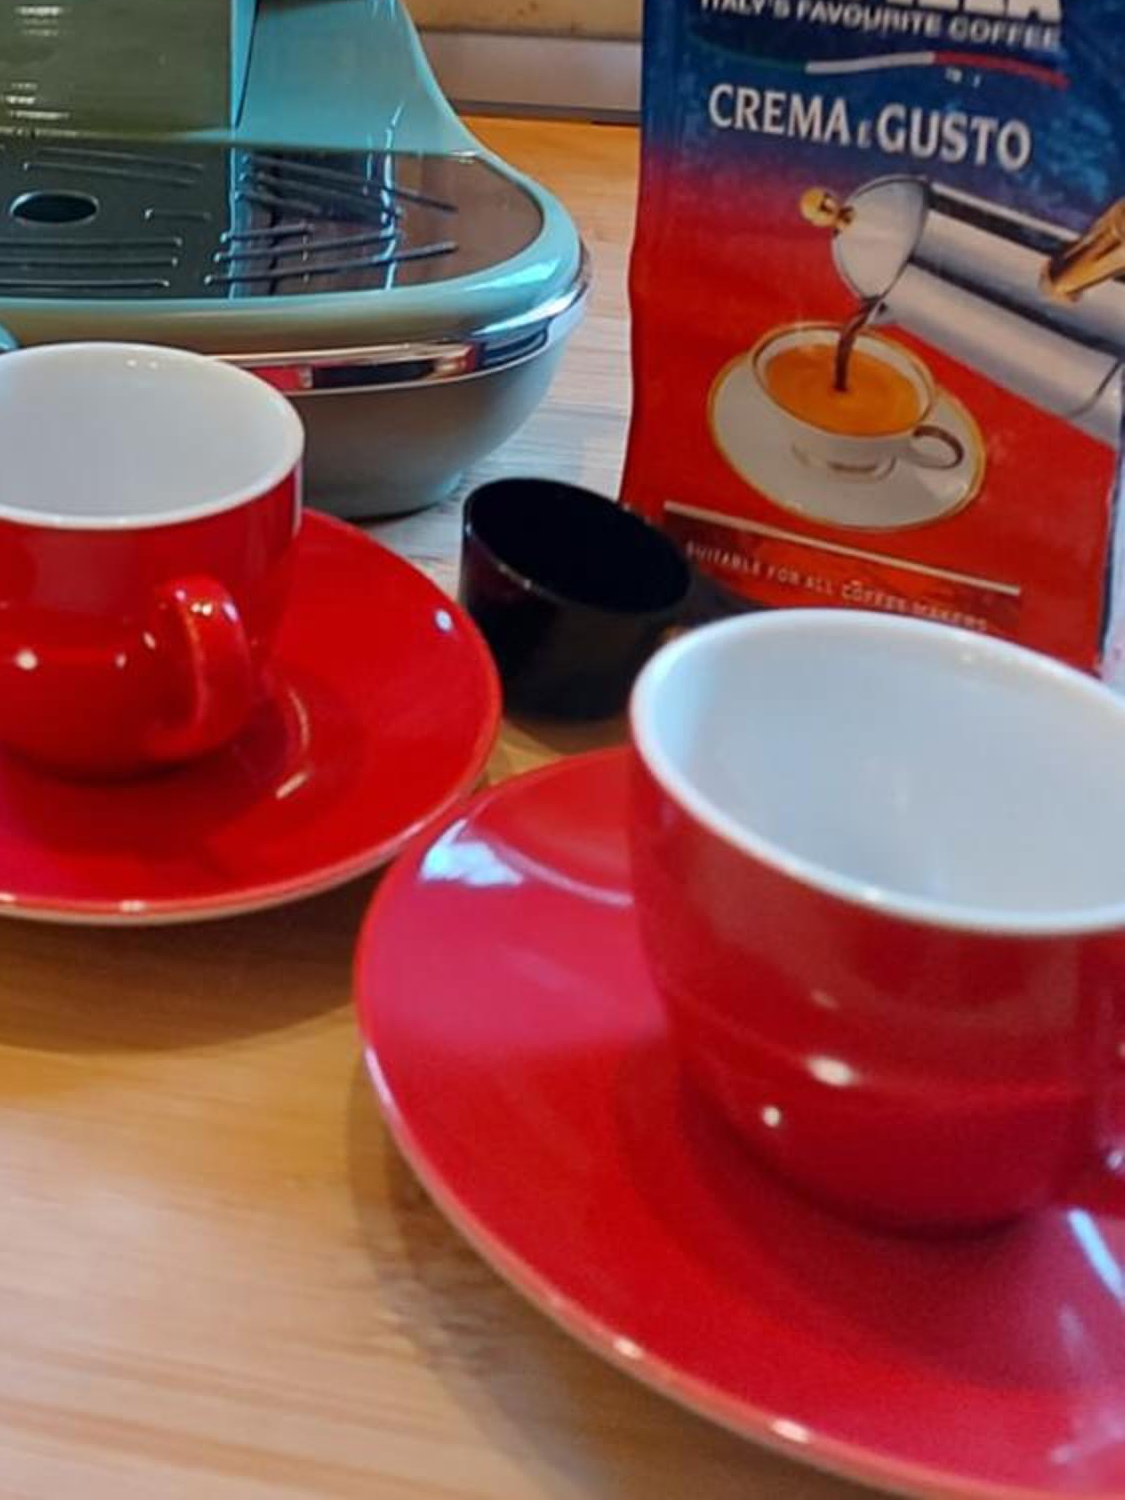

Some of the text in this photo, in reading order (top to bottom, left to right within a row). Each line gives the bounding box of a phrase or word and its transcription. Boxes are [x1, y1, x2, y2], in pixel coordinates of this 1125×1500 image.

[949, 14, 1060, 50] COFFEE
[708, 83, 850, 148] CREMA
[877, 103, 1031, 171] GUSTO
[766, 565, 800, 586] FOR
[805, 575, 835, 597] ALL
